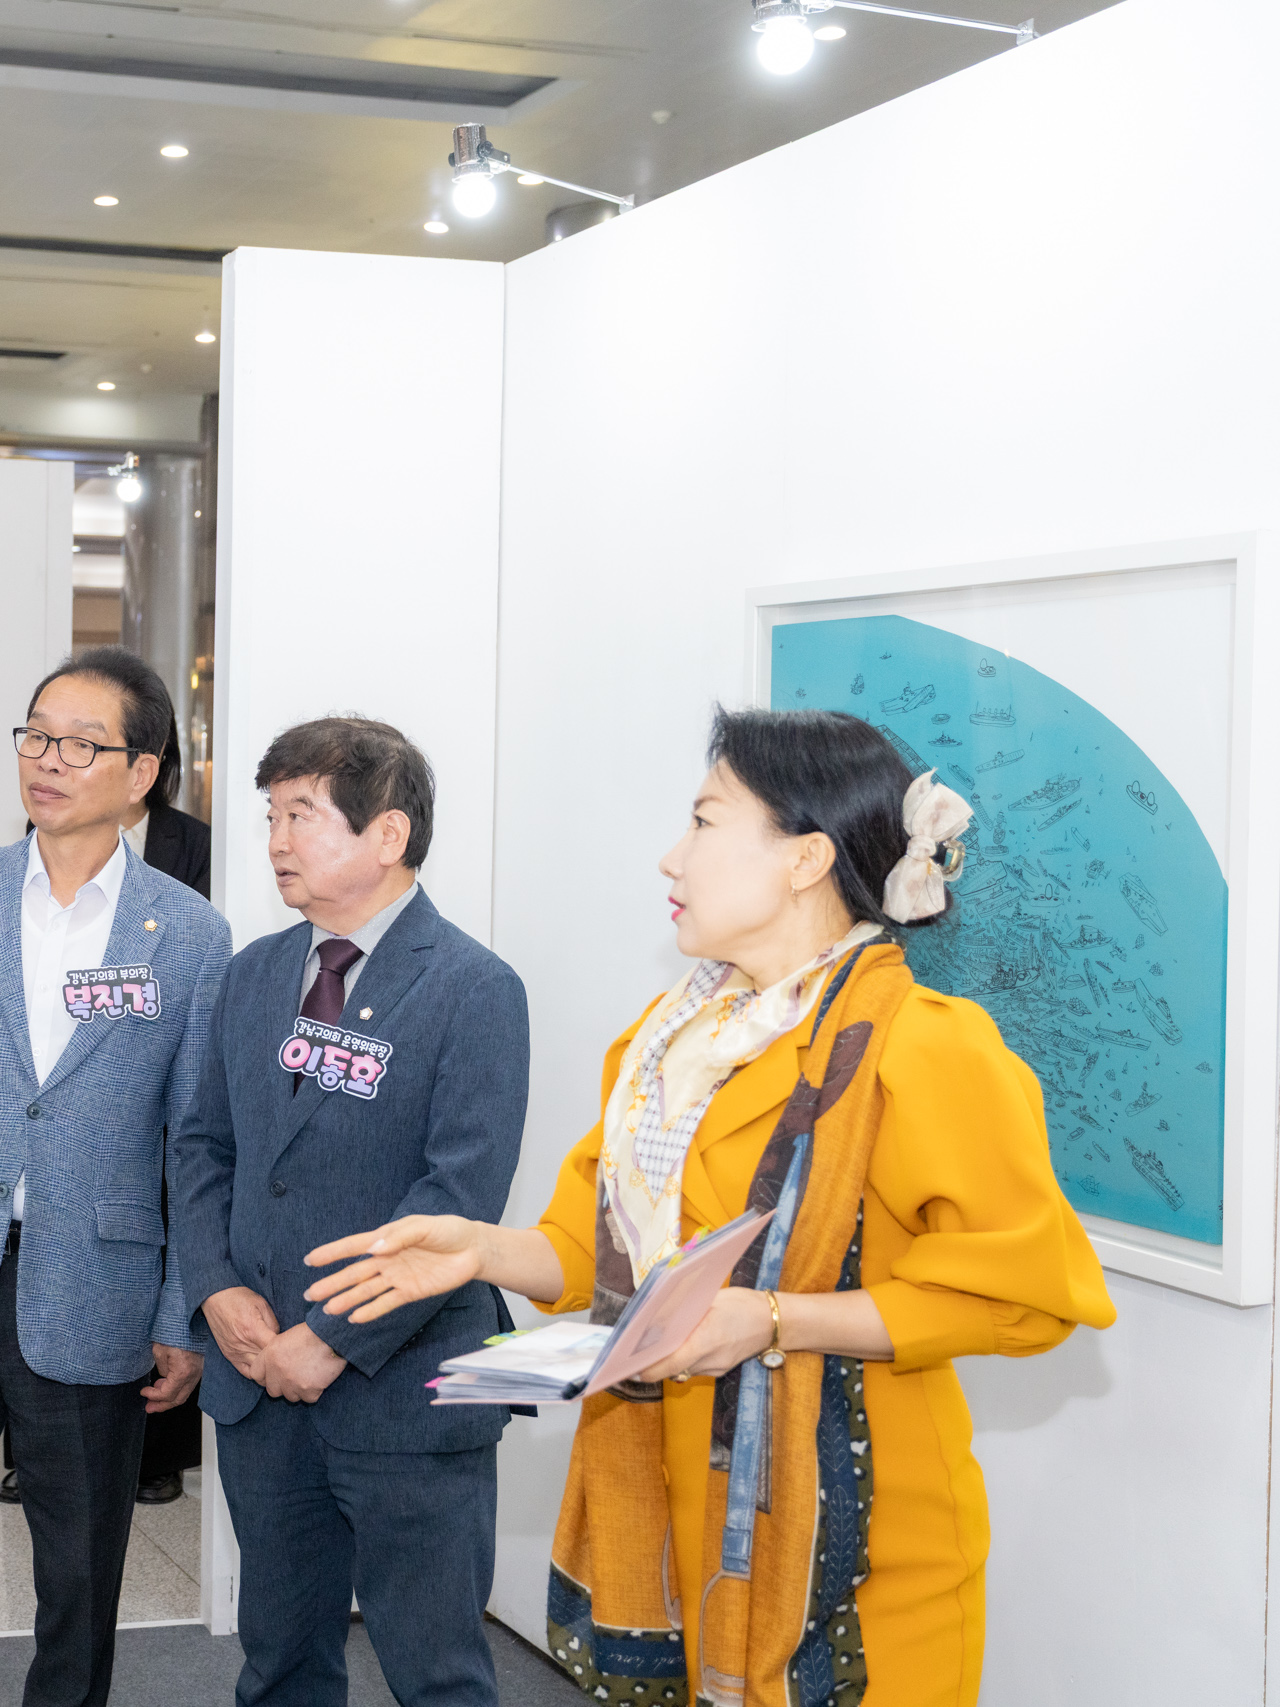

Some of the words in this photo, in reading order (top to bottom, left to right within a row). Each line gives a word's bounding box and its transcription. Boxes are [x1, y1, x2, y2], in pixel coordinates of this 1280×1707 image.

[69, 970, 117, 985] 강남구의회
[119, 967, 149, 980] 부의장
[65, 982, 157, 1019] 복진경
[298, 1021, 342, 1042] 강남구의회
[341, 1034, 388, 1059] 운영위원장
[283, 1038, 382, 1095] 이동호
